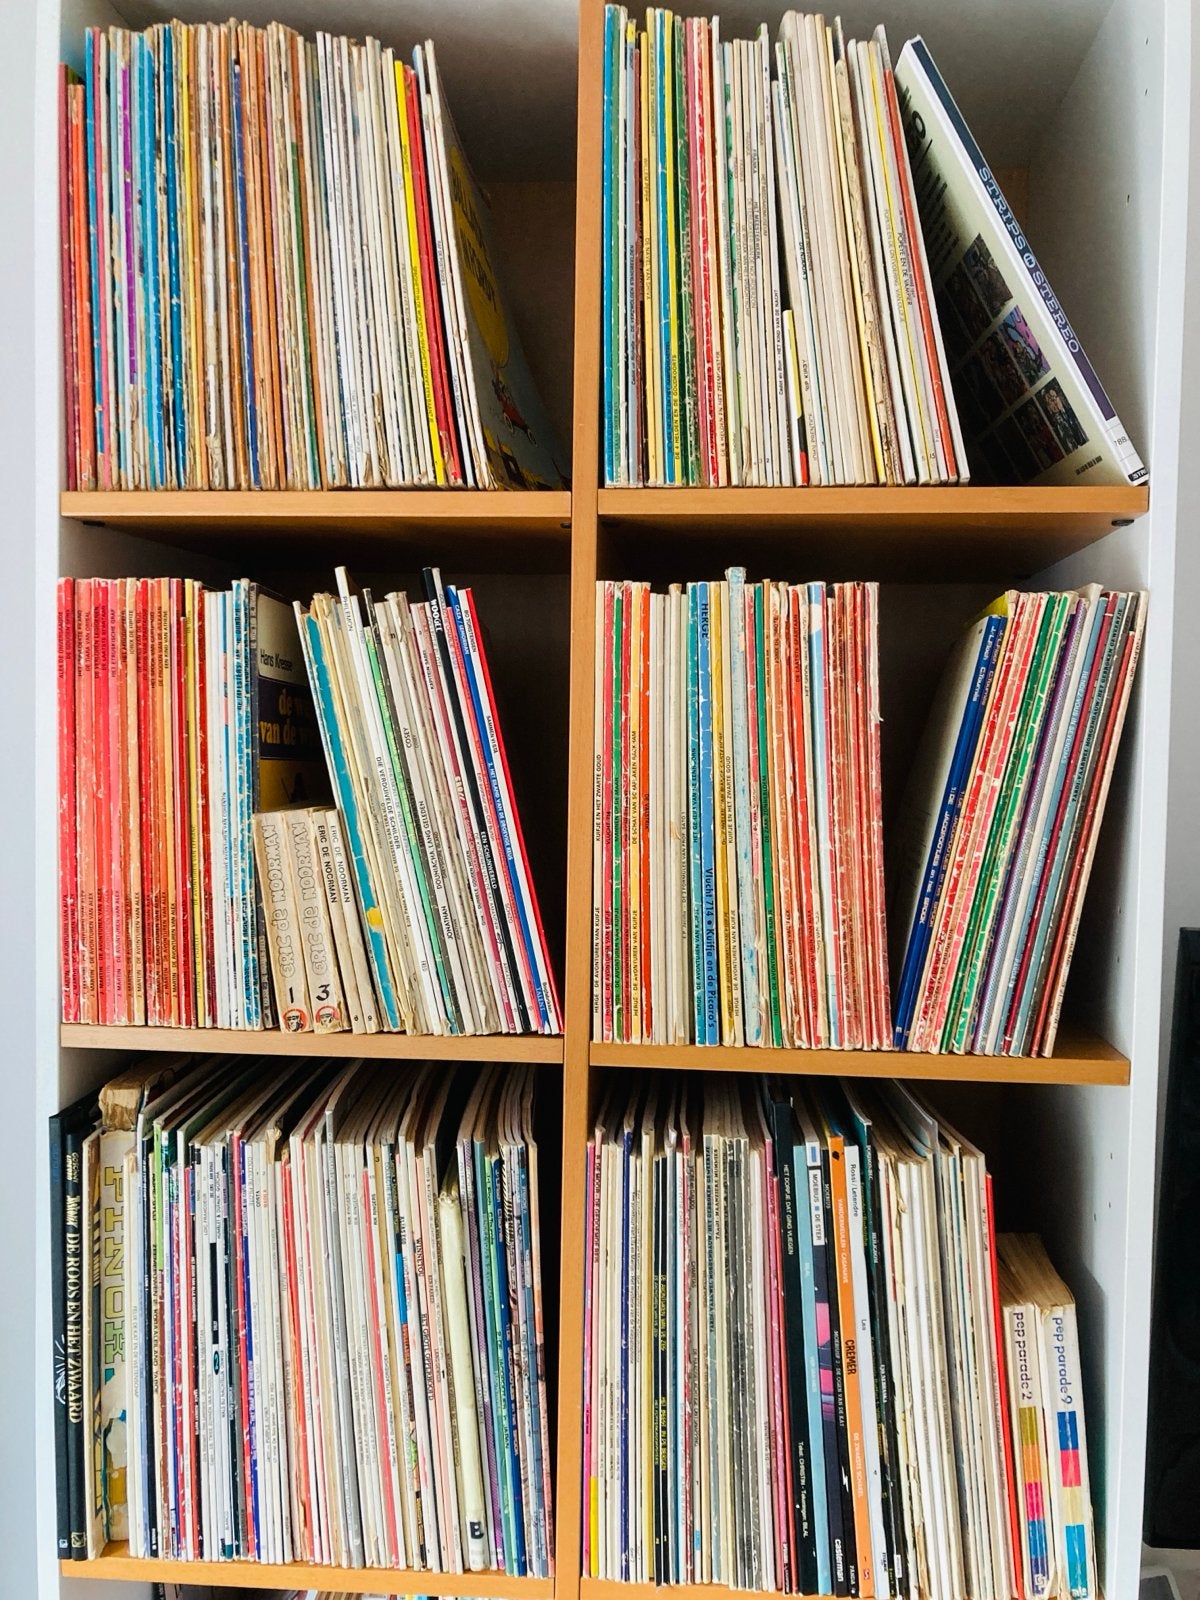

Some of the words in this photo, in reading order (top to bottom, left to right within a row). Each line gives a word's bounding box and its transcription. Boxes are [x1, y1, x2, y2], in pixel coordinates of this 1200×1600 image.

[896, 231, 905, 257] POPEYE
[900, 257, 907, 267] EN
[979, 166, 1026, 250] STRIPS
[1032, 270, 1080, 353] STEREO
[901, 268, 908, 278] DE
[774, 308, 780, 316] DE
[673, 397, 678, 406] DE
[673, 408, 679, 417] EN
[674, 451, 680, 459] DE
[341, 595, 353, 632] PHILEMON
[463, 609, 470, 618] BO
[465, 618, 477, 652] TORSTENSEN
[260, 648, 274, 668] Hans
[275, 654, 293, 672] Kresse
[402, 726, 412, 748] COSEY
[485, 714, 495, 738] SAMMEN
[374, 756, 383, 769] DIE
[377, 768, 394, 815] VERDUIVELDE
[418, 800, 429, 829] GELEDEN
[727, 813, 733, 822] EN
[317, 824, 327, 843] ERIC
[388, 815, 401, 850] SCHILDER
[424, 829, 434, 848] LANG
[479, 830, 487, 843] EEN
[321, 846, 329, 857] DE
[333, 846, 342, 857] DE
[481, 843, 498, 889] SCHIJNWERELD
[336, 860, 350, 903] NOORMAN
[704, 867, 713, 897] Vlucht
[262, 824, 286, 902] NOORMAN
[289, 986, 294, 1004] 1
[292, 822, 316, 900] NOORMAN
[316, 984, 330, 1002] 3
[704, 900, 714, 916] 714
[440, 905, 453, 940] JONATHAN
[705, 928, 714, 956] Kuifje
[705, 960, 715, 972] en
[594, 979, 599, 987] DE
[706, 974, 715, 986] de
[535, 986, 545, 1011] TALENT
[781, 1164, 789, 1176] HET
[848, 1163, 858, 1183] Rossi
[782, 1177, 790, 1200] DORPJE
[811, 1173, 820, 1202] MOEBIUS
[783, 1201, 791, 1213] DAT
[850, 1186, 861, 1217] Letendre
[784, 1214, 792, 1229] GING
[813, 1213, 821, 1221] DE
[785, 1230, 794, 1255] VLIEGEN
[814, 1222, 822, 1240] STER
[67, 1232, 80, 1254] DE
[67, 1257, 80, 1298] ROOS
[67, 1302, 80, 1323] EN
[1013, 1312, 1026, 1337] pep
[1052, 1318, 1064, 1342] pep
[68, 1324, 81, 1355] HET
[843, 1338, 858, 1375] CREMER
[1015, 1341, 1032, 1390] parade
[1054, 1346, 1072, 1394] parade
[68, 1358, 82, 1423] ZWAARD
[1022, 1392, 1032, 1400] 2
[1061, 1395, 1072, 1404] 9
[833, 1538, 844, 1582] casterman
